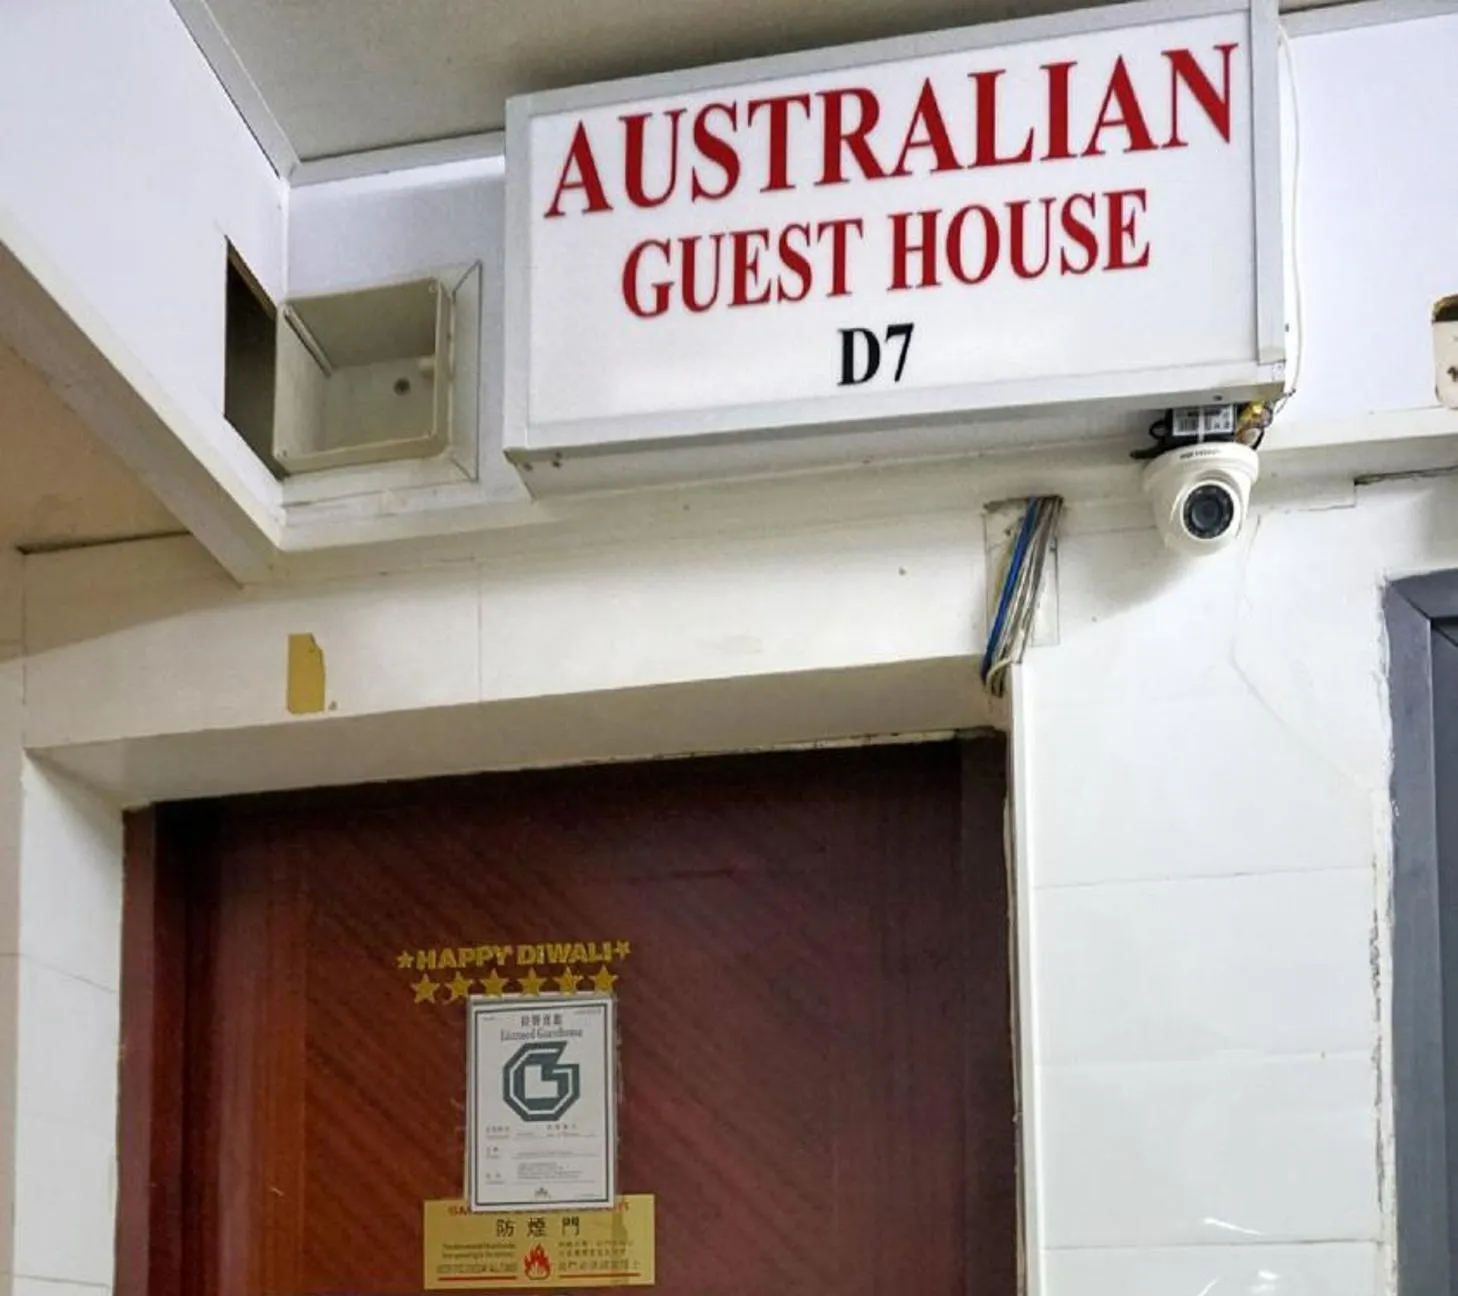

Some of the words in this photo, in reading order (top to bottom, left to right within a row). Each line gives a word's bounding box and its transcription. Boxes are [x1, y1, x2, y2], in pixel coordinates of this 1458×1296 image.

[544, 42, 1239, 219] AUSTRALIAN
[622, 217, 864, 320] GUEST
[886, 188, 1151, 293] HOUSE
[836, 322, 915, 387] D7
[415, 945, 513, 970] HAPPY
[516, 941, 613, 965] DIWALI
